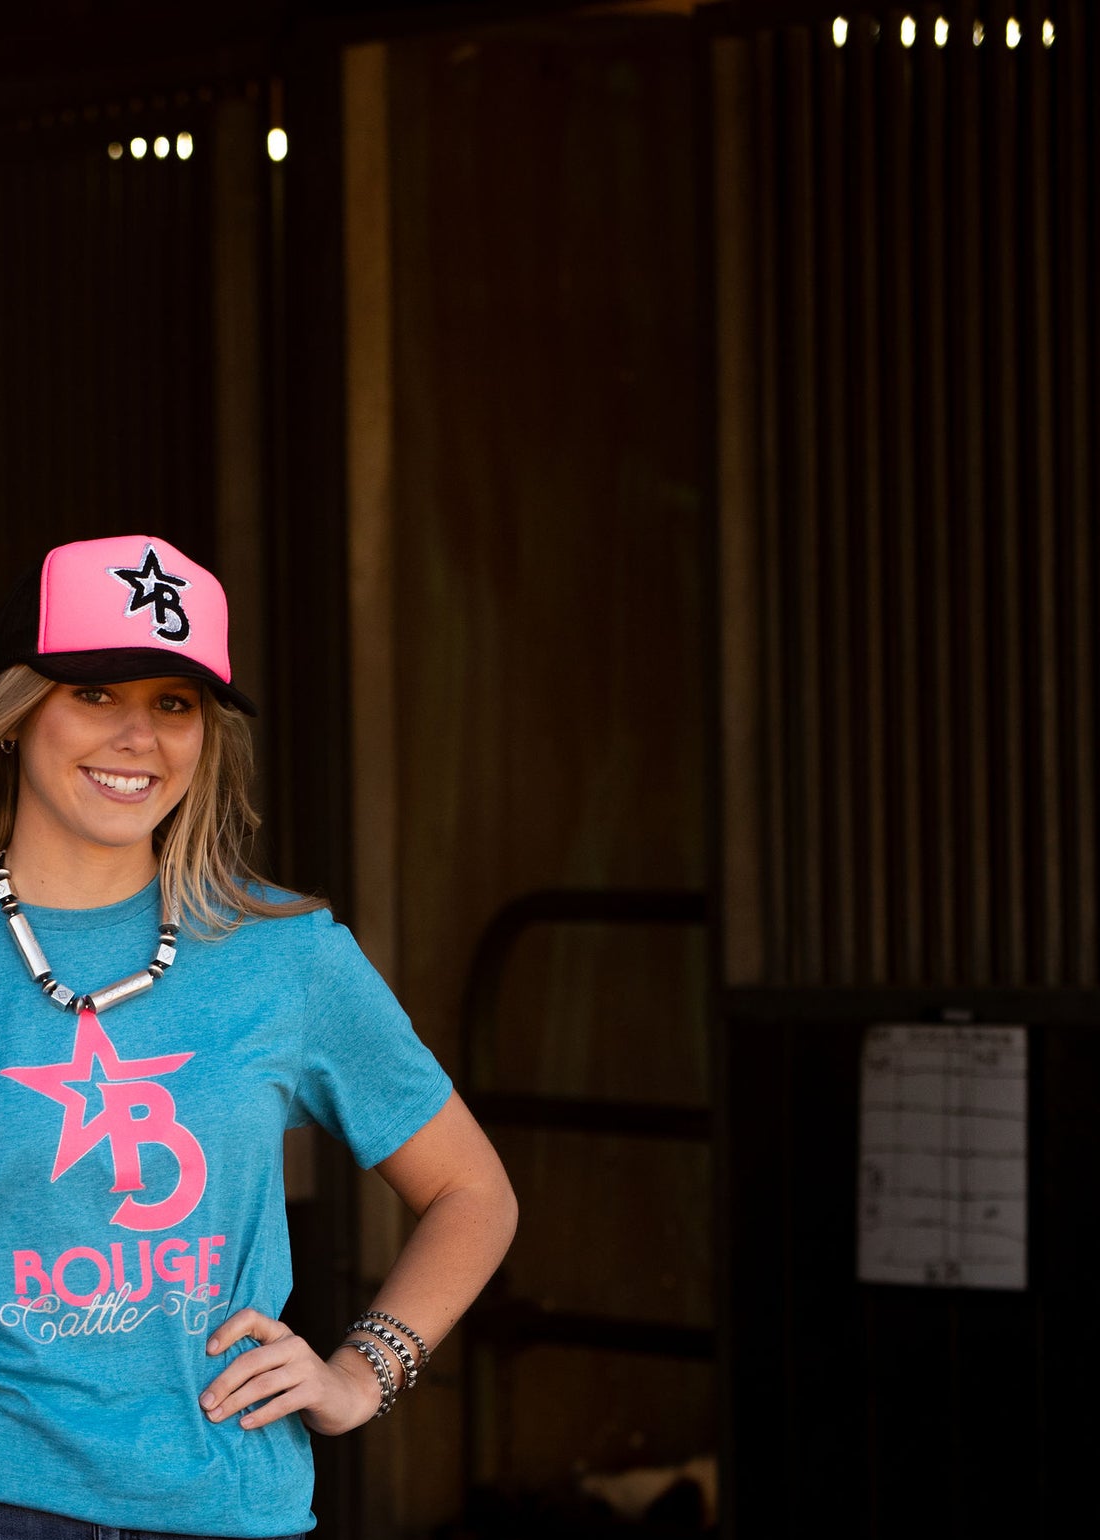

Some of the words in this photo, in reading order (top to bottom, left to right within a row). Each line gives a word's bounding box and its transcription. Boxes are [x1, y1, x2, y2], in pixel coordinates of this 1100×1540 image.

[151, 582, 191, 645] B
[97, 1081, 207, 1231] B
[0, 1282, 162, 1344] Cattle
